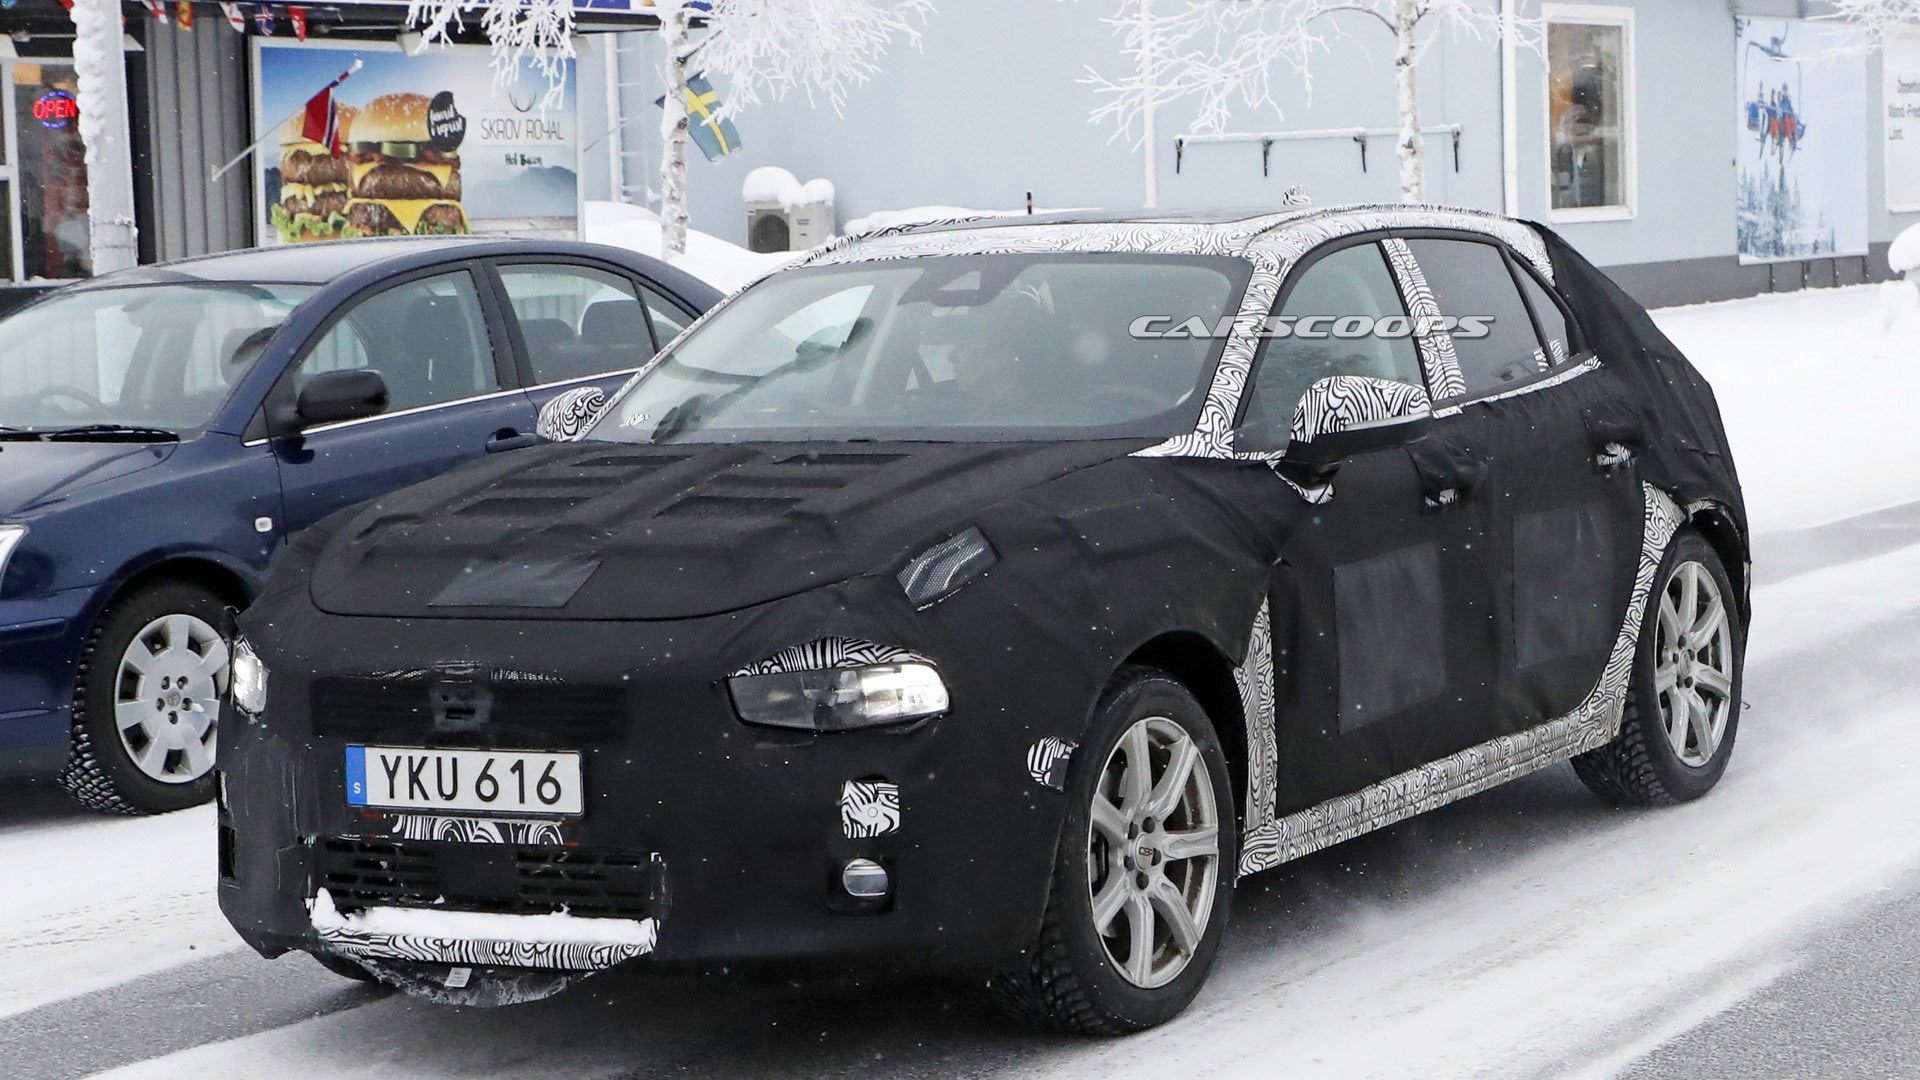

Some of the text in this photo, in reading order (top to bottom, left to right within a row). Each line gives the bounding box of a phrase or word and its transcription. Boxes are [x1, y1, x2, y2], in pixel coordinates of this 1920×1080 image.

[32, 99, 76, 118] OPEN
[481, 118, 565, 140] SKROV ROYAL
[353, 781, 362, 795] S
[380, 754, 562, 806] YKU 616
